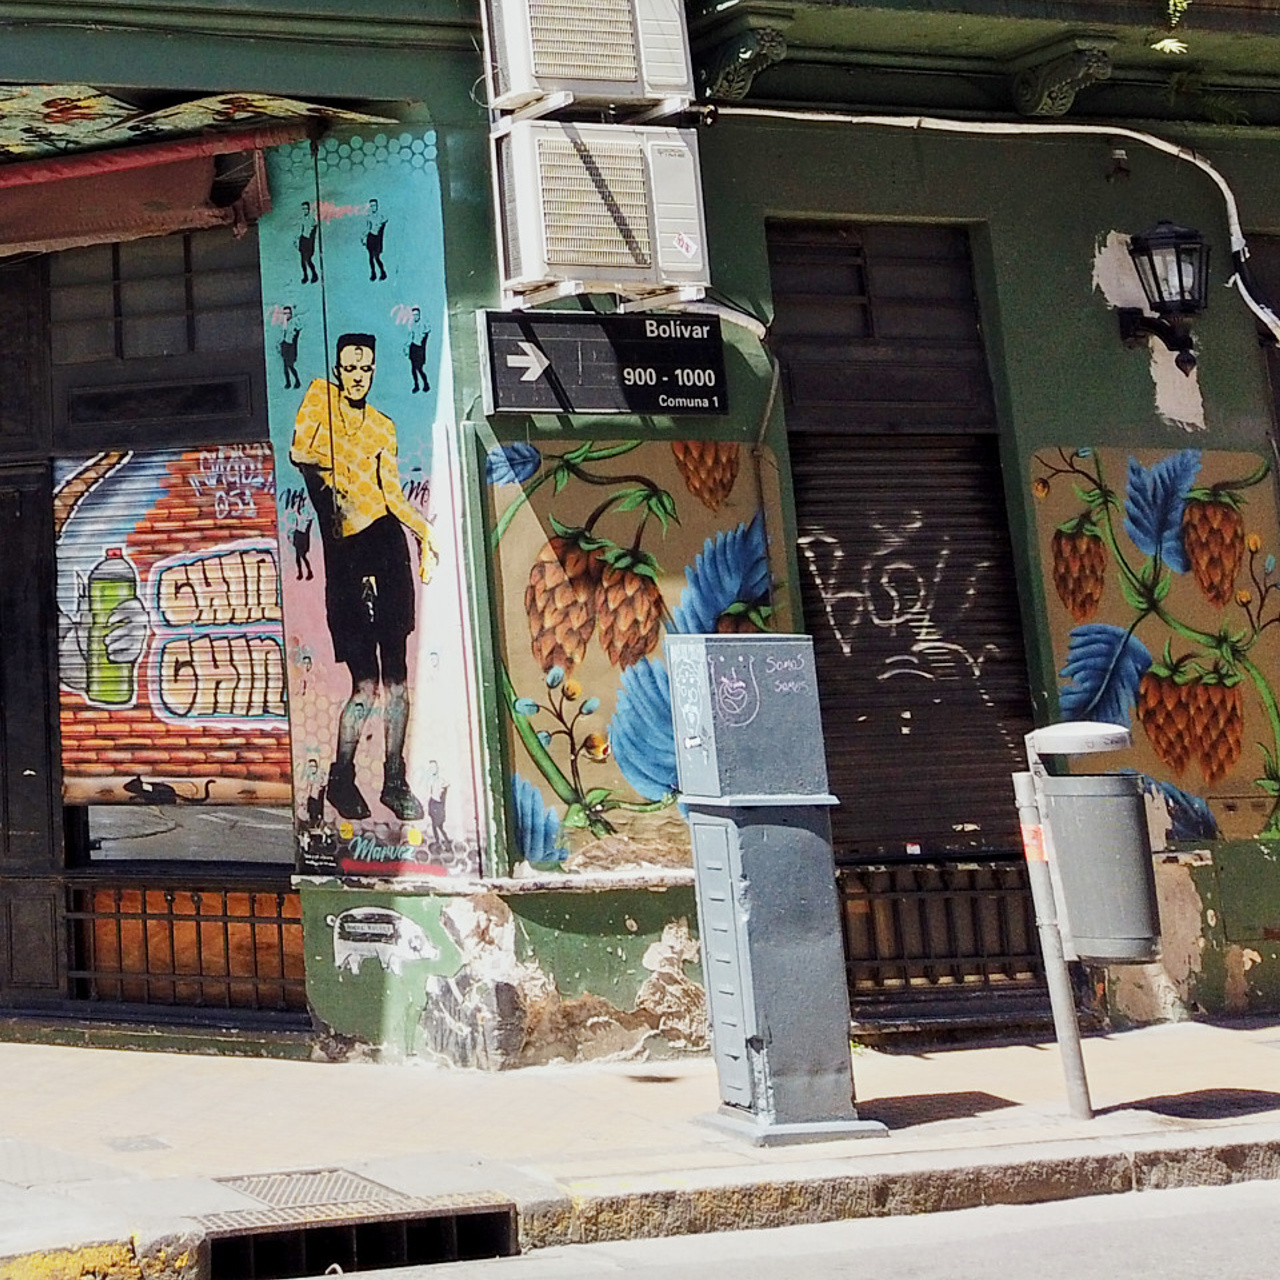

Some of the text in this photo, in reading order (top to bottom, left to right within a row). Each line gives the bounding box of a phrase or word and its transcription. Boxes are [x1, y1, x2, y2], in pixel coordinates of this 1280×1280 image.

[645, 320, 710, 340] Bolívar
[623, 368, 656, 386] 900
[674, 369, 716, 387] 1000
[658, 394, 719, 408] Comuna 1
